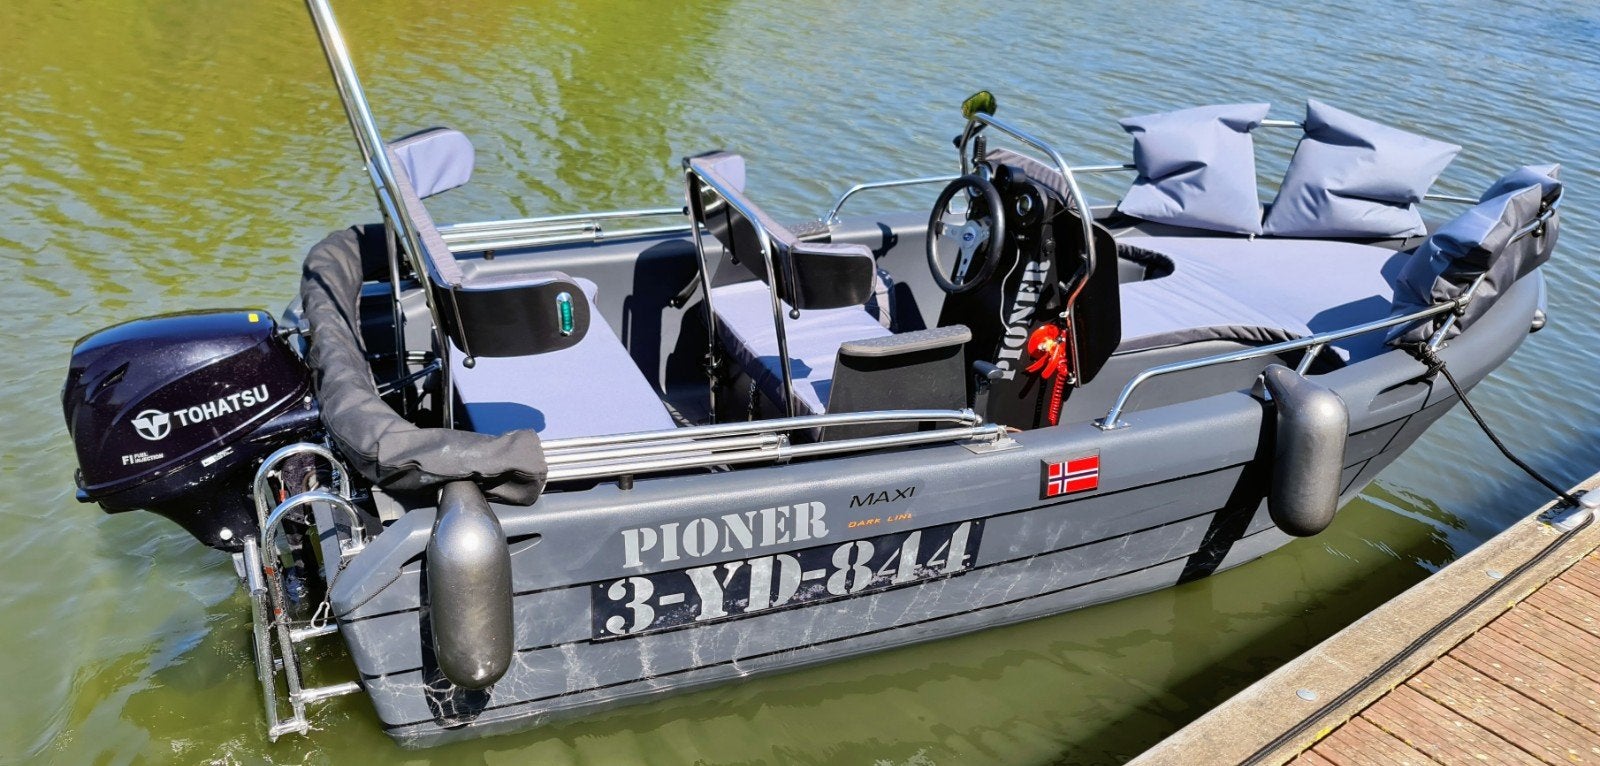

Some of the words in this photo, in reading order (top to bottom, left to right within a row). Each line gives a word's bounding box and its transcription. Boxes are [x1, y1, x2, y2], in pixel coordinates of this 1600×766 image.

[996, 260, 1051, 381] PIONER
[173, 384, 269, 427] TOHATSU
[122, 455, 134, 465] FI
[849, 486, 916, 509] MAXI
[621, 500, 830, 570] PIONER
[848, 518, 881, 529] DARK
[605, 521, 972, 635] 3-YD-844
